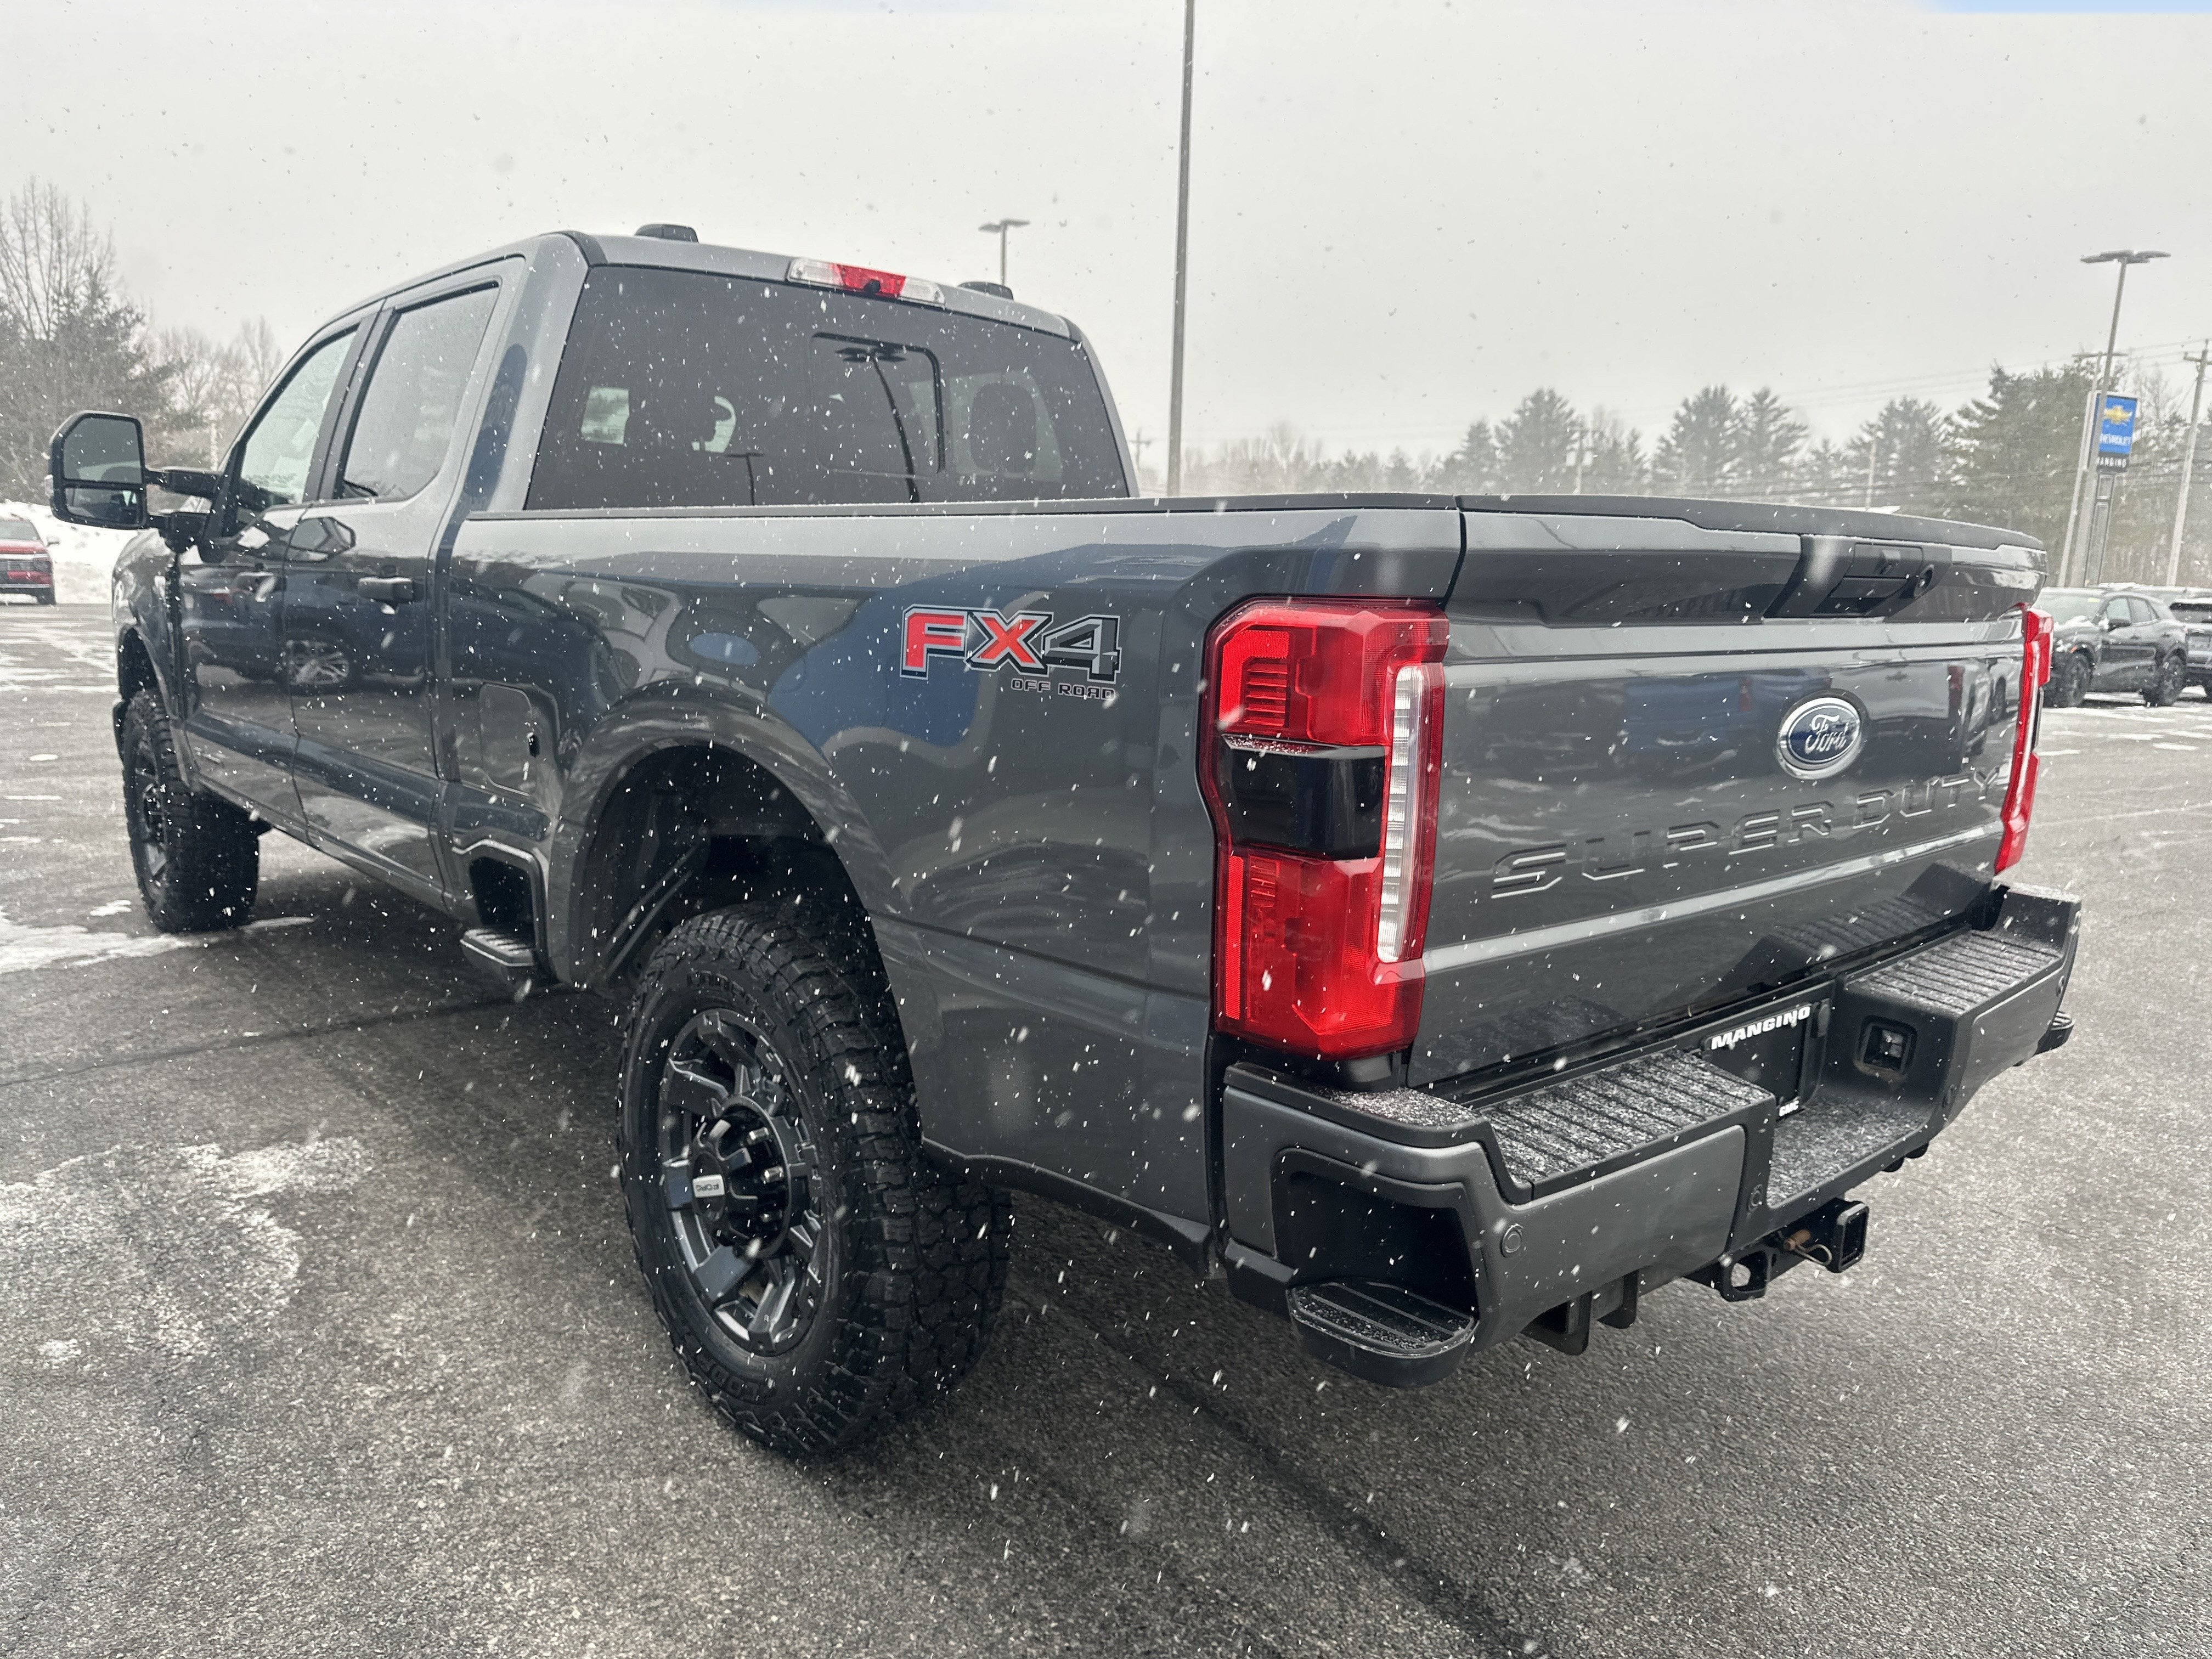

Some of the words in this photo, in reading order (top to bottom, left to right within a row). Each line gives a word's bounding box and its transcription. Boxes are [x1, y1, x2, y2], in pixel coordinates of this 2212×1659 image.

[2100, 433, 2132, 447] HEVROLET
[900, 604, 1121, 684] FX4
[1011, 678, 1051, 693] OFF
[1058, 682, 1116, 700] ROAD
[1805, 714, 1849, 754] Ford
[1491, 801, 1835, 899] SUPER
[1853, 767, 2000, 830] DUTY
[1711, 1006, 1811, 1050] MANGINO
